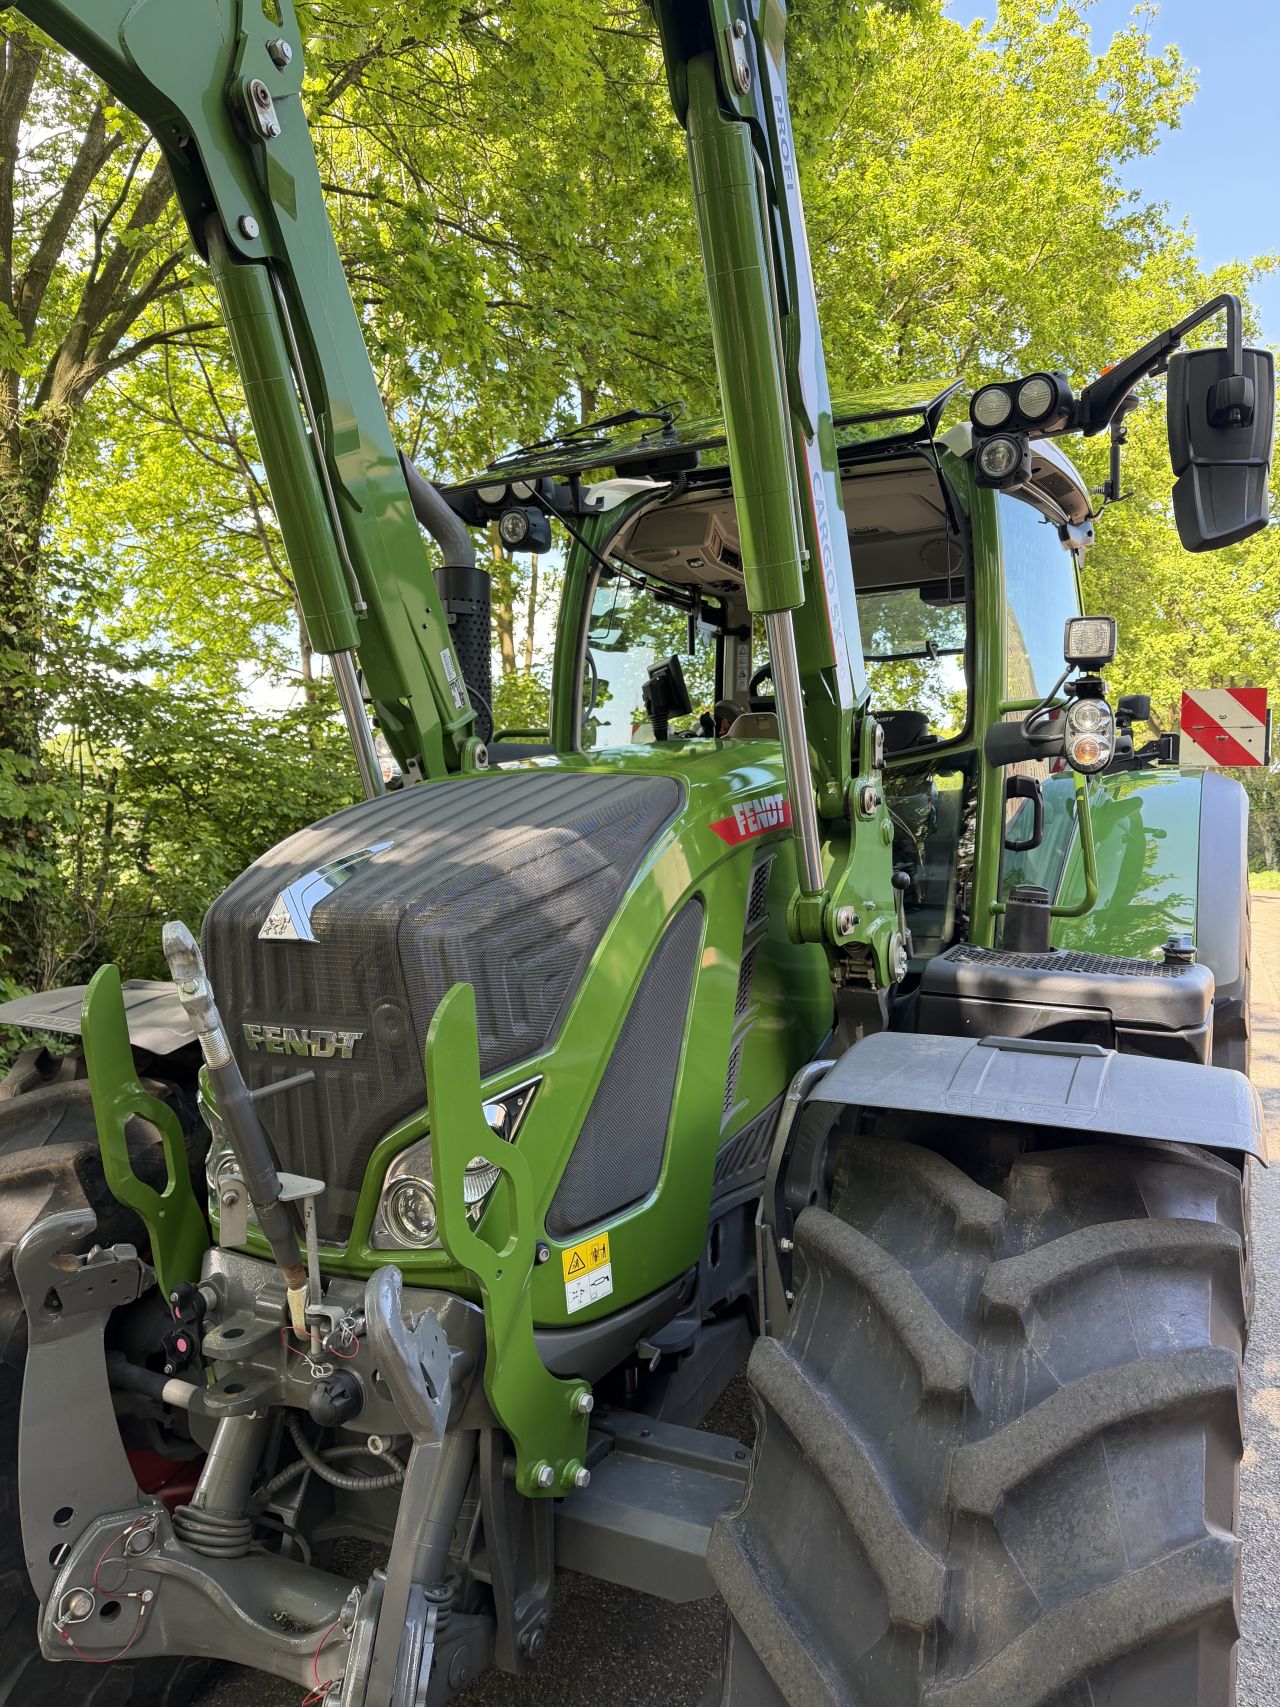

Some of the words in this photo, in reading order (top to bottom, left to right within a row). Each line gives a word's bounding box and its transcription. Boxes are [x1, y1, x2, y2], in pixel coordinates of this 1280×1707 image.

[774, 95, 794, 190] PROFI
[813, 472, 835, 595] CARGO
[732, 792, 785, 836] FENDT
[241, 1023, 364, 1059] FENDT
